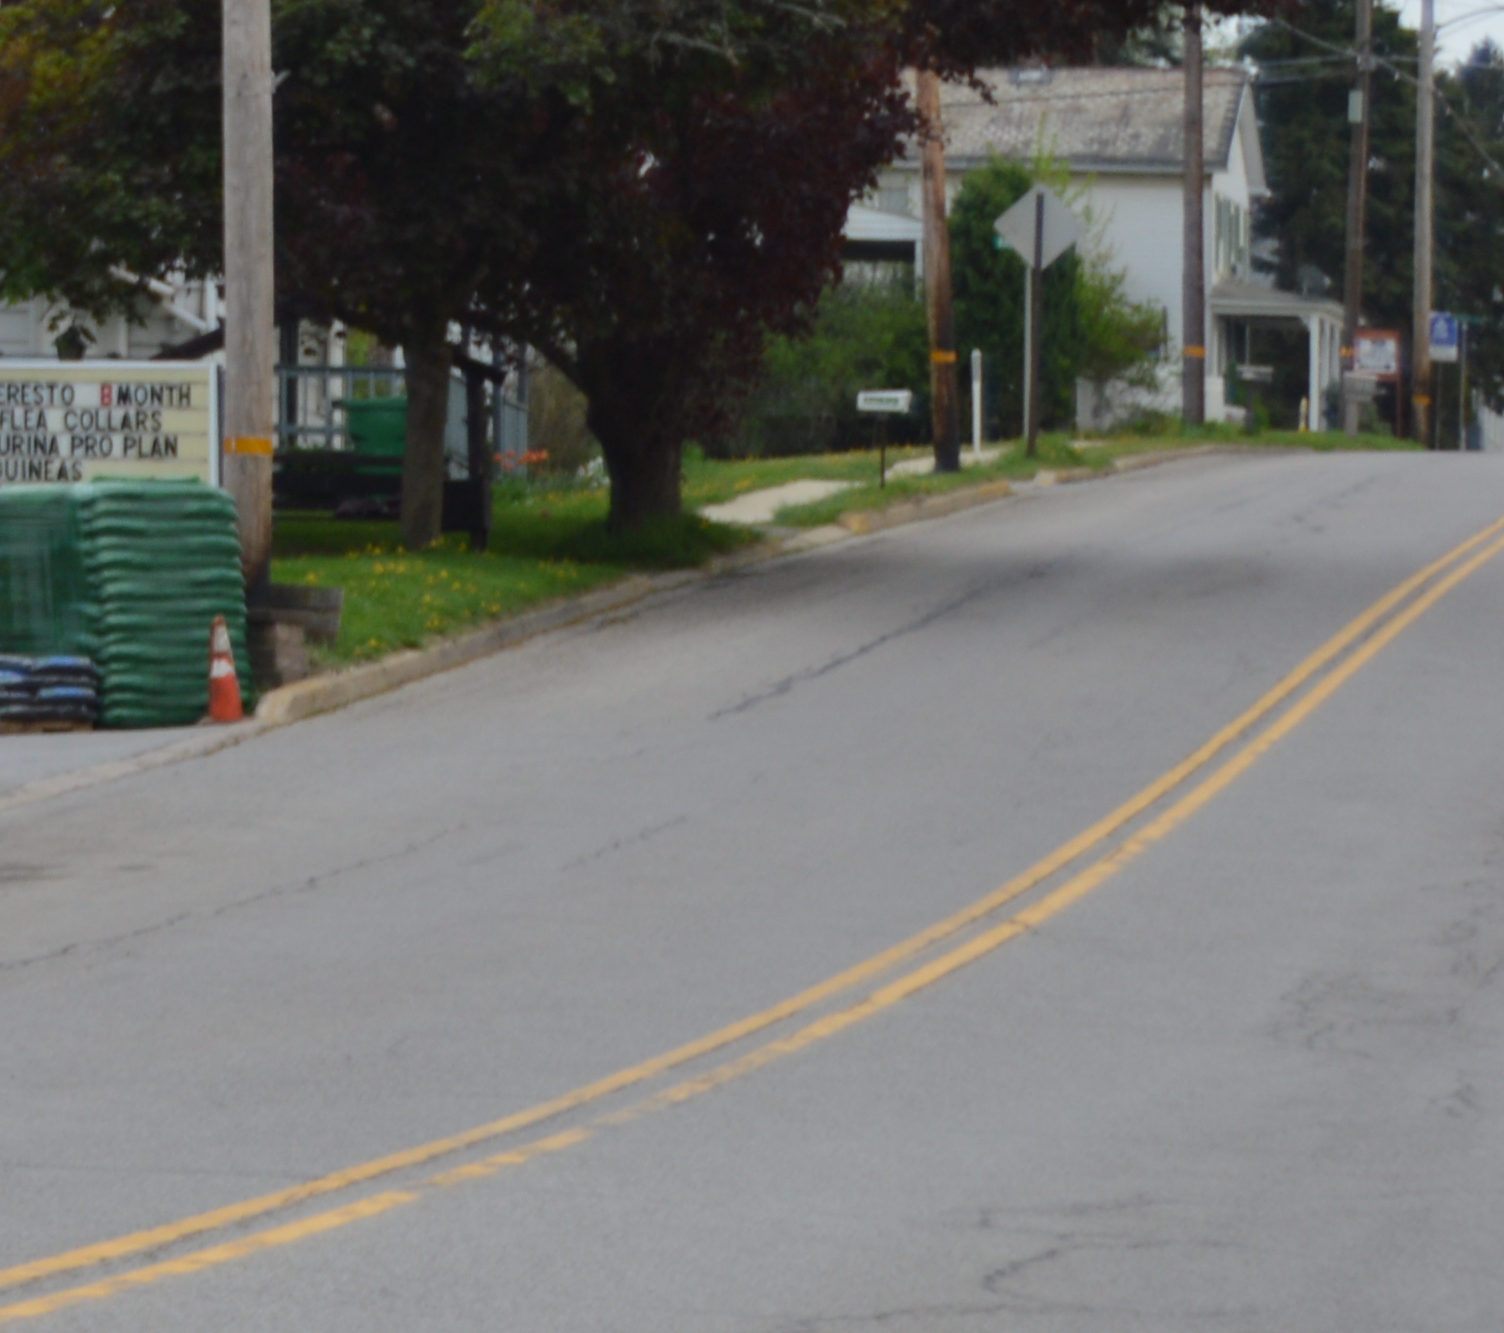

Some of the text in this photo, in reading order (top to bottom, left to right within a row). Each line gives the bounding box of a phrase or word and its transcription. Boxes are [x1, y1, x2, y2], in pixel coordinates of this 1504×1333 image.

[116, 383, 192, 407] MONTH
[63, 408, 163, 433] COLLARS
[70, 435, 113, 458] PRO
[123, 435, 178, 459] PLAN
